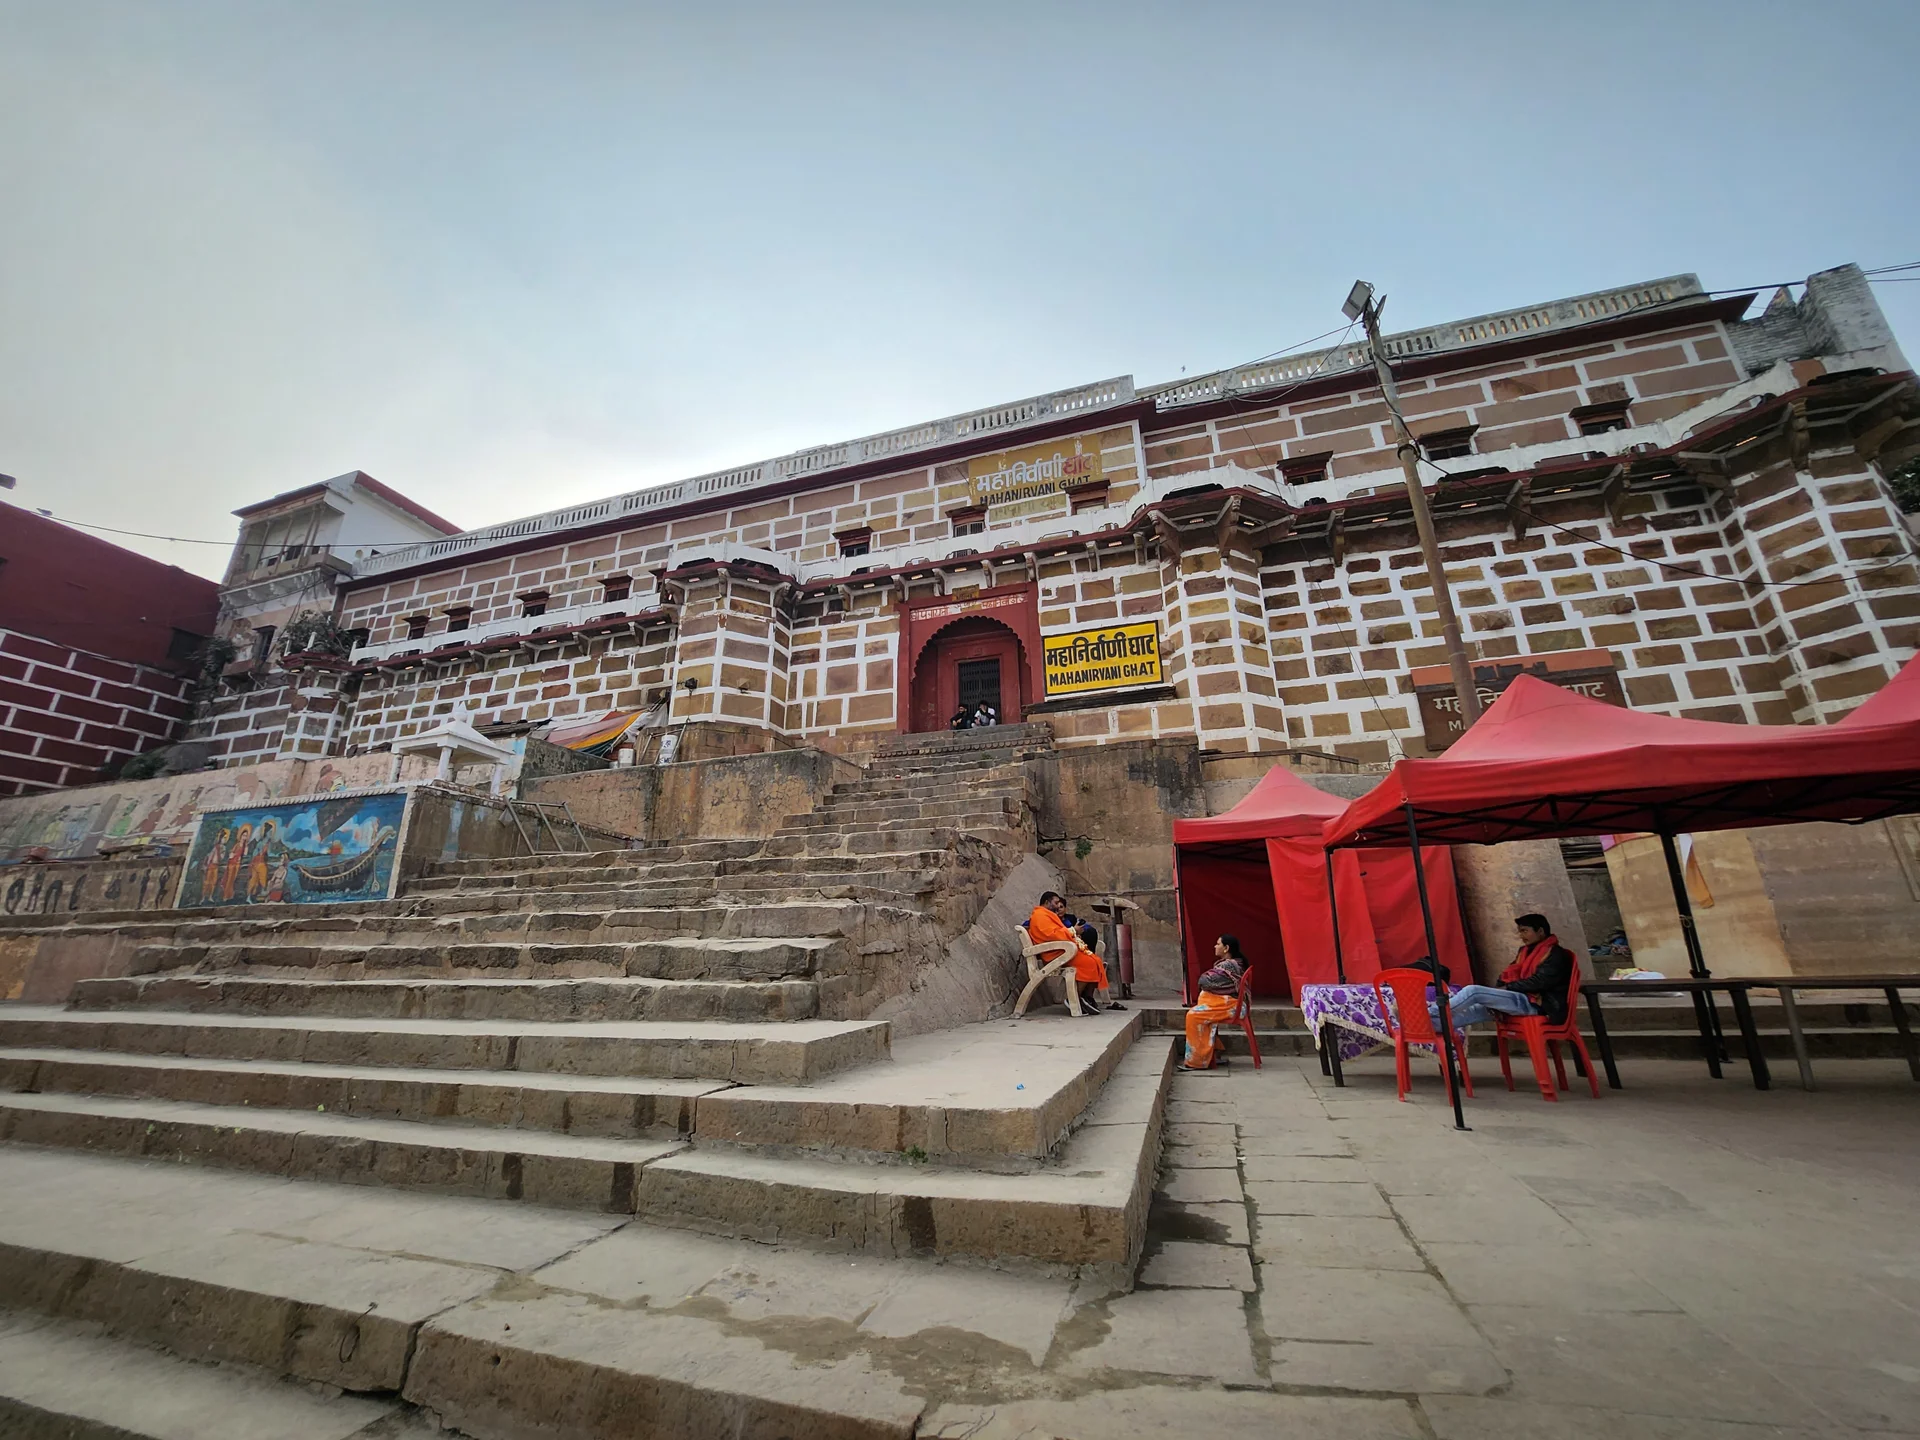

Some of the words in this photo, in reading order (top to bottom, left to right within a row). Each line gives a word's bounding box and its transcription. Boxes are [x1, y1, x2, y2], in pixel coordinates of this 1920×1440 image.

[976, 452, 1062, 492] महानिर्वाणी
[980, 482, 1056, 505] MAHANIRVANI
[1046, 631, 1128, 668] महानिर्वाणी
[1127, 634, 1155, 656] घाट
[1049, 666, 1122, 687] MAHANIRVANI
[1123, 661, 1156, 678] GHAT
